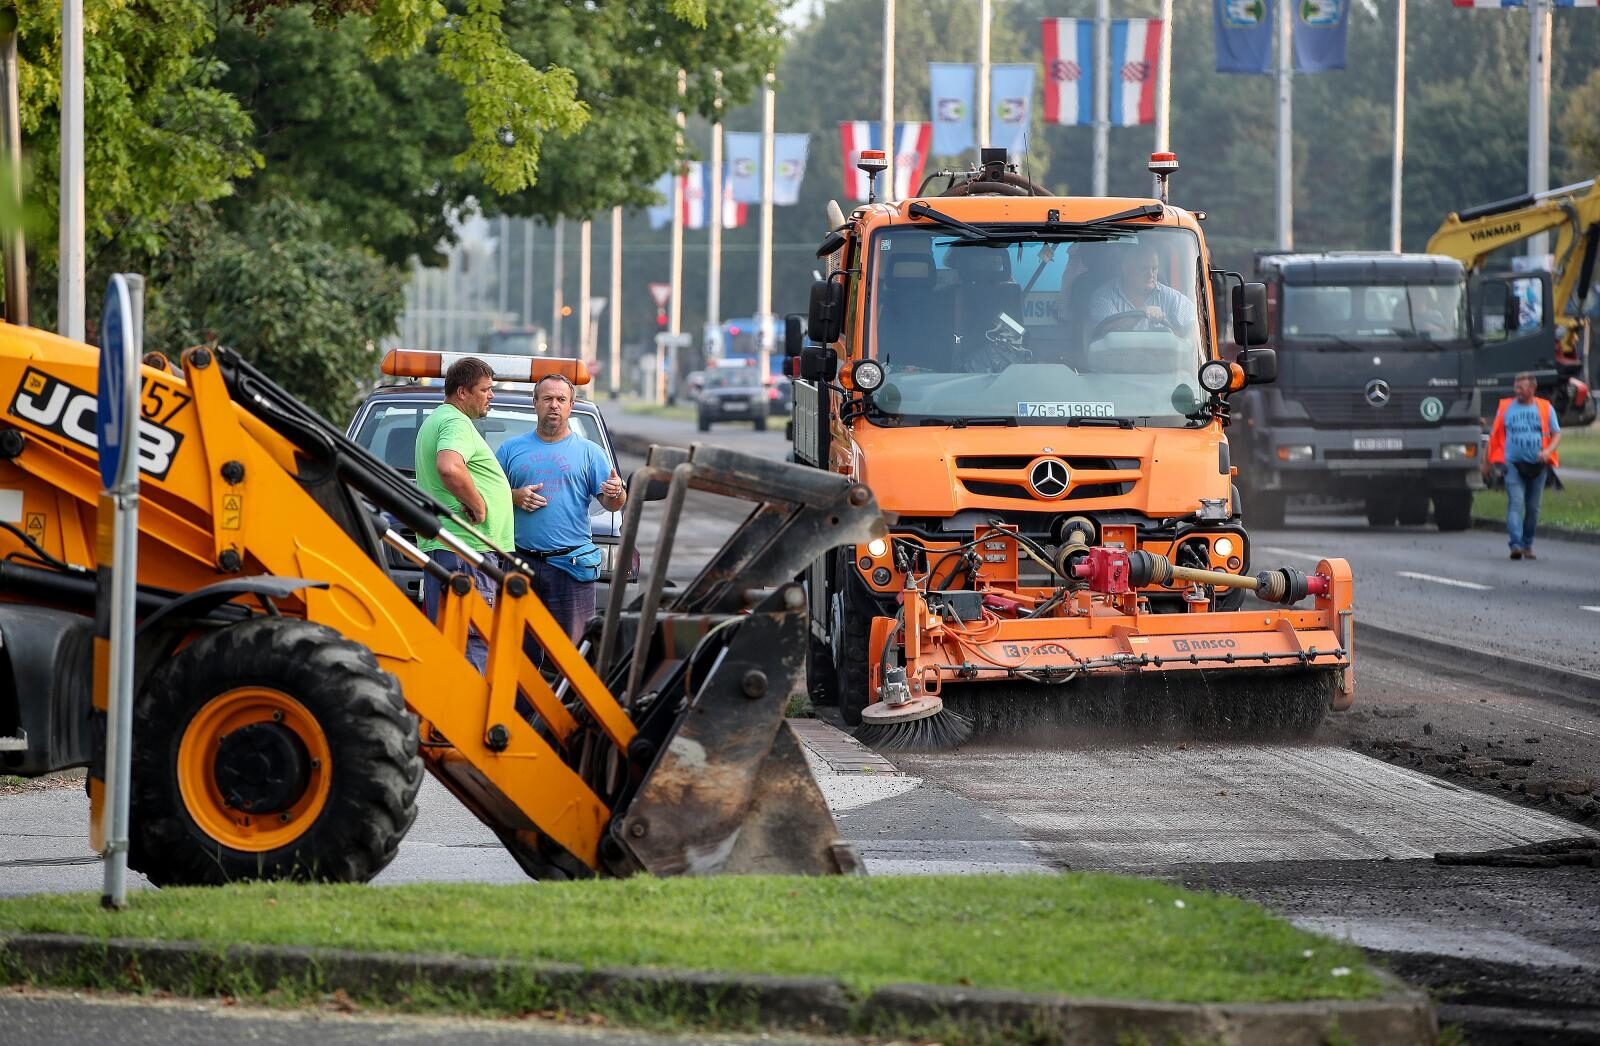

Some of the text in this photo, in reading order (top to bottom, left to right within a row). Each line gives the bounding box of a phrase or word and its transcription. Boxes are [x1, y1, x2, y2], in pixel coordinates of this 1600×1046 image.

[1470, 222, 1521, 241] YANMAR
[1028, 405, 1047, 417] ZG
[15, 383, 176, 475] JCB
[1191, 639, 1236, 650] RASCO
